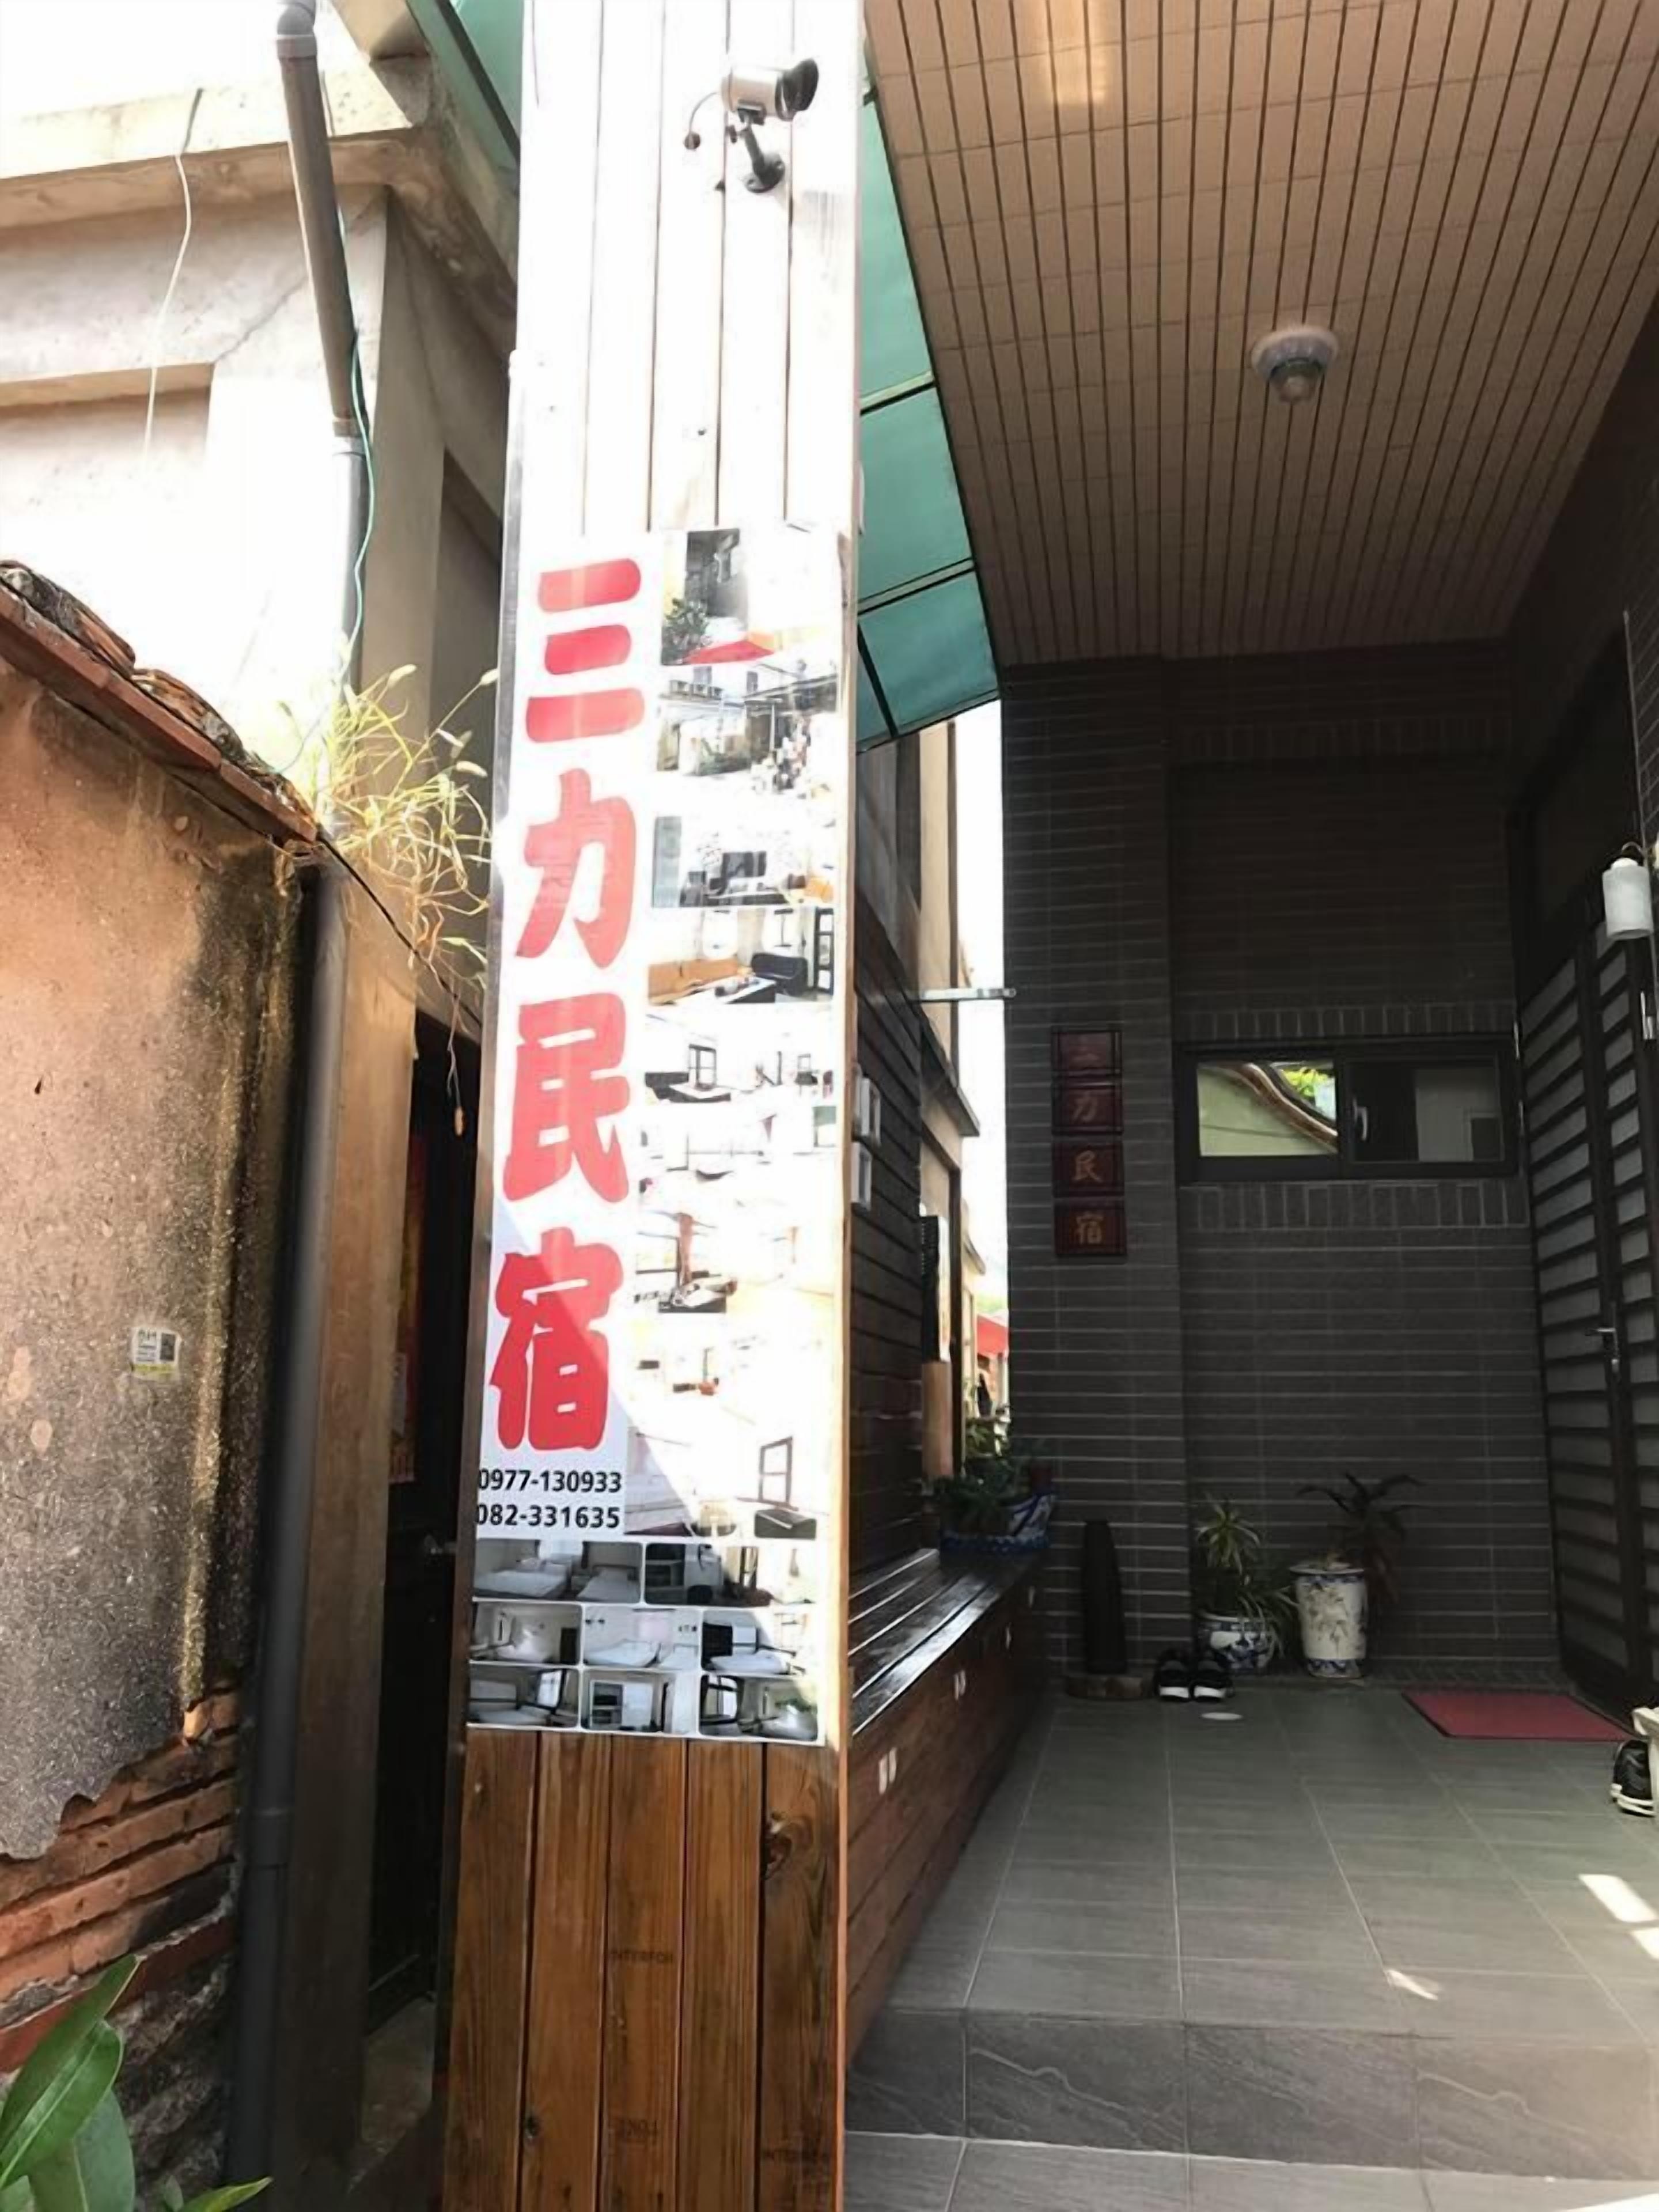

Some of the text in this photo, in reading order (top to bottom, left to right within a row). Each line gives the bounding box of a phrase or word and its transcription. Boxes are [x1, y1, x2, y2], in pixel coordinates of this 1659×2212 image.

[490, 558, 645, 1451] 三力民宿
[478, 1468, 622, 1493] 0977-130933
[475, 1503, 620, 1528] 082-331635
